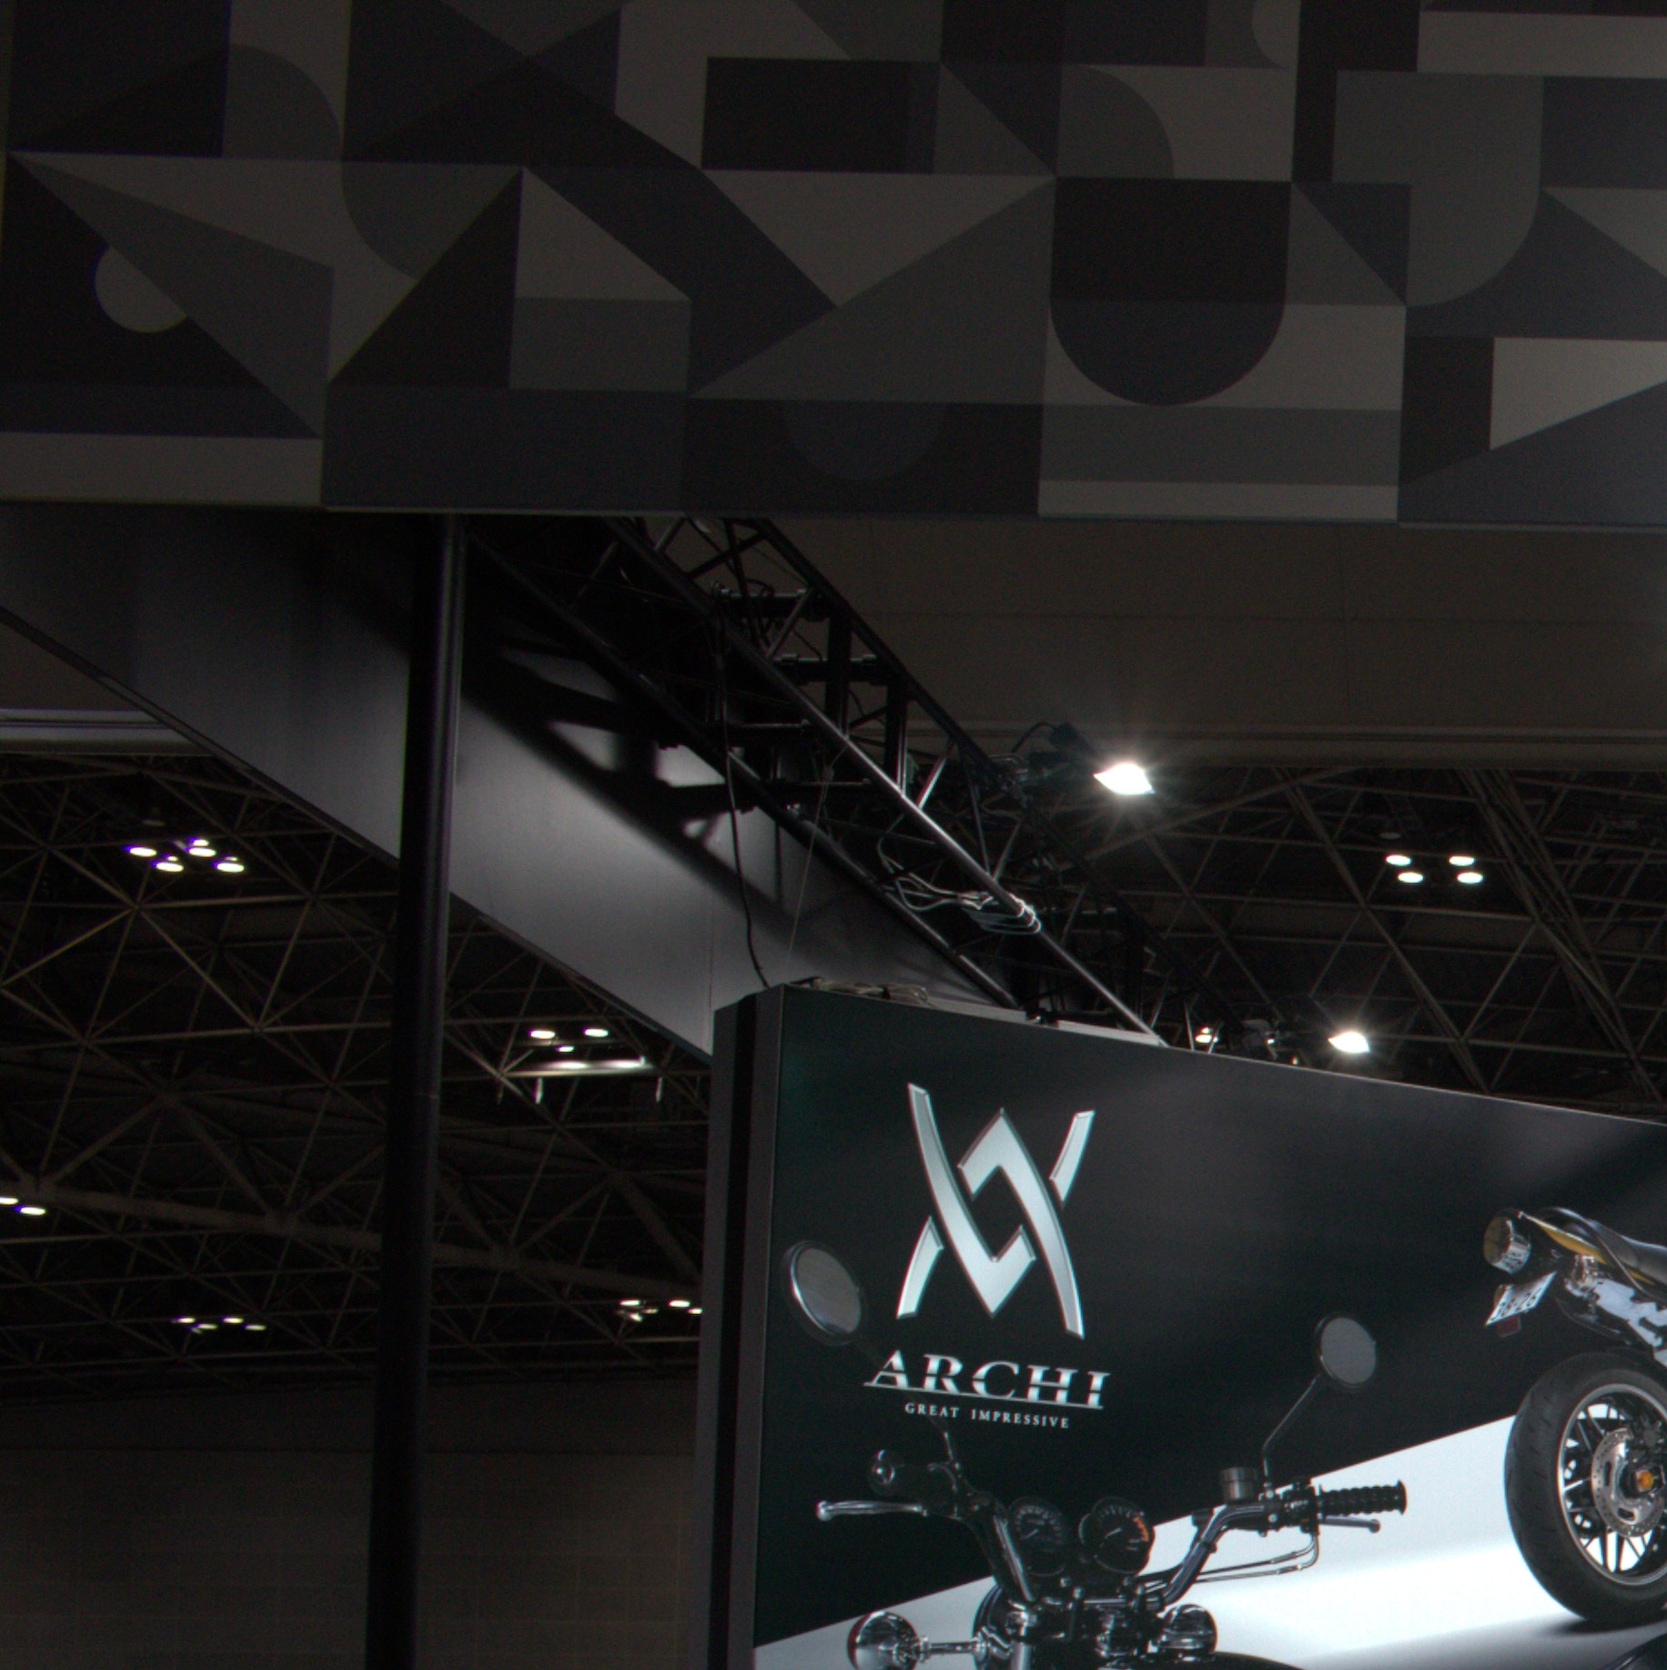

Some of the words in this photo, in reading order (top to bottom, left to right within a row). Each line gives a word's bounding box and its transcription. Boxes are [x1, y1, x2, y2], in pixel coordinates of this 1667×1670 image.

[864, 1350, 1110, 1410] ARCHI
[905, 1402, 958, 1420] GREAT
[971, 1409, 1070, 1429] IMPRESSIVE
